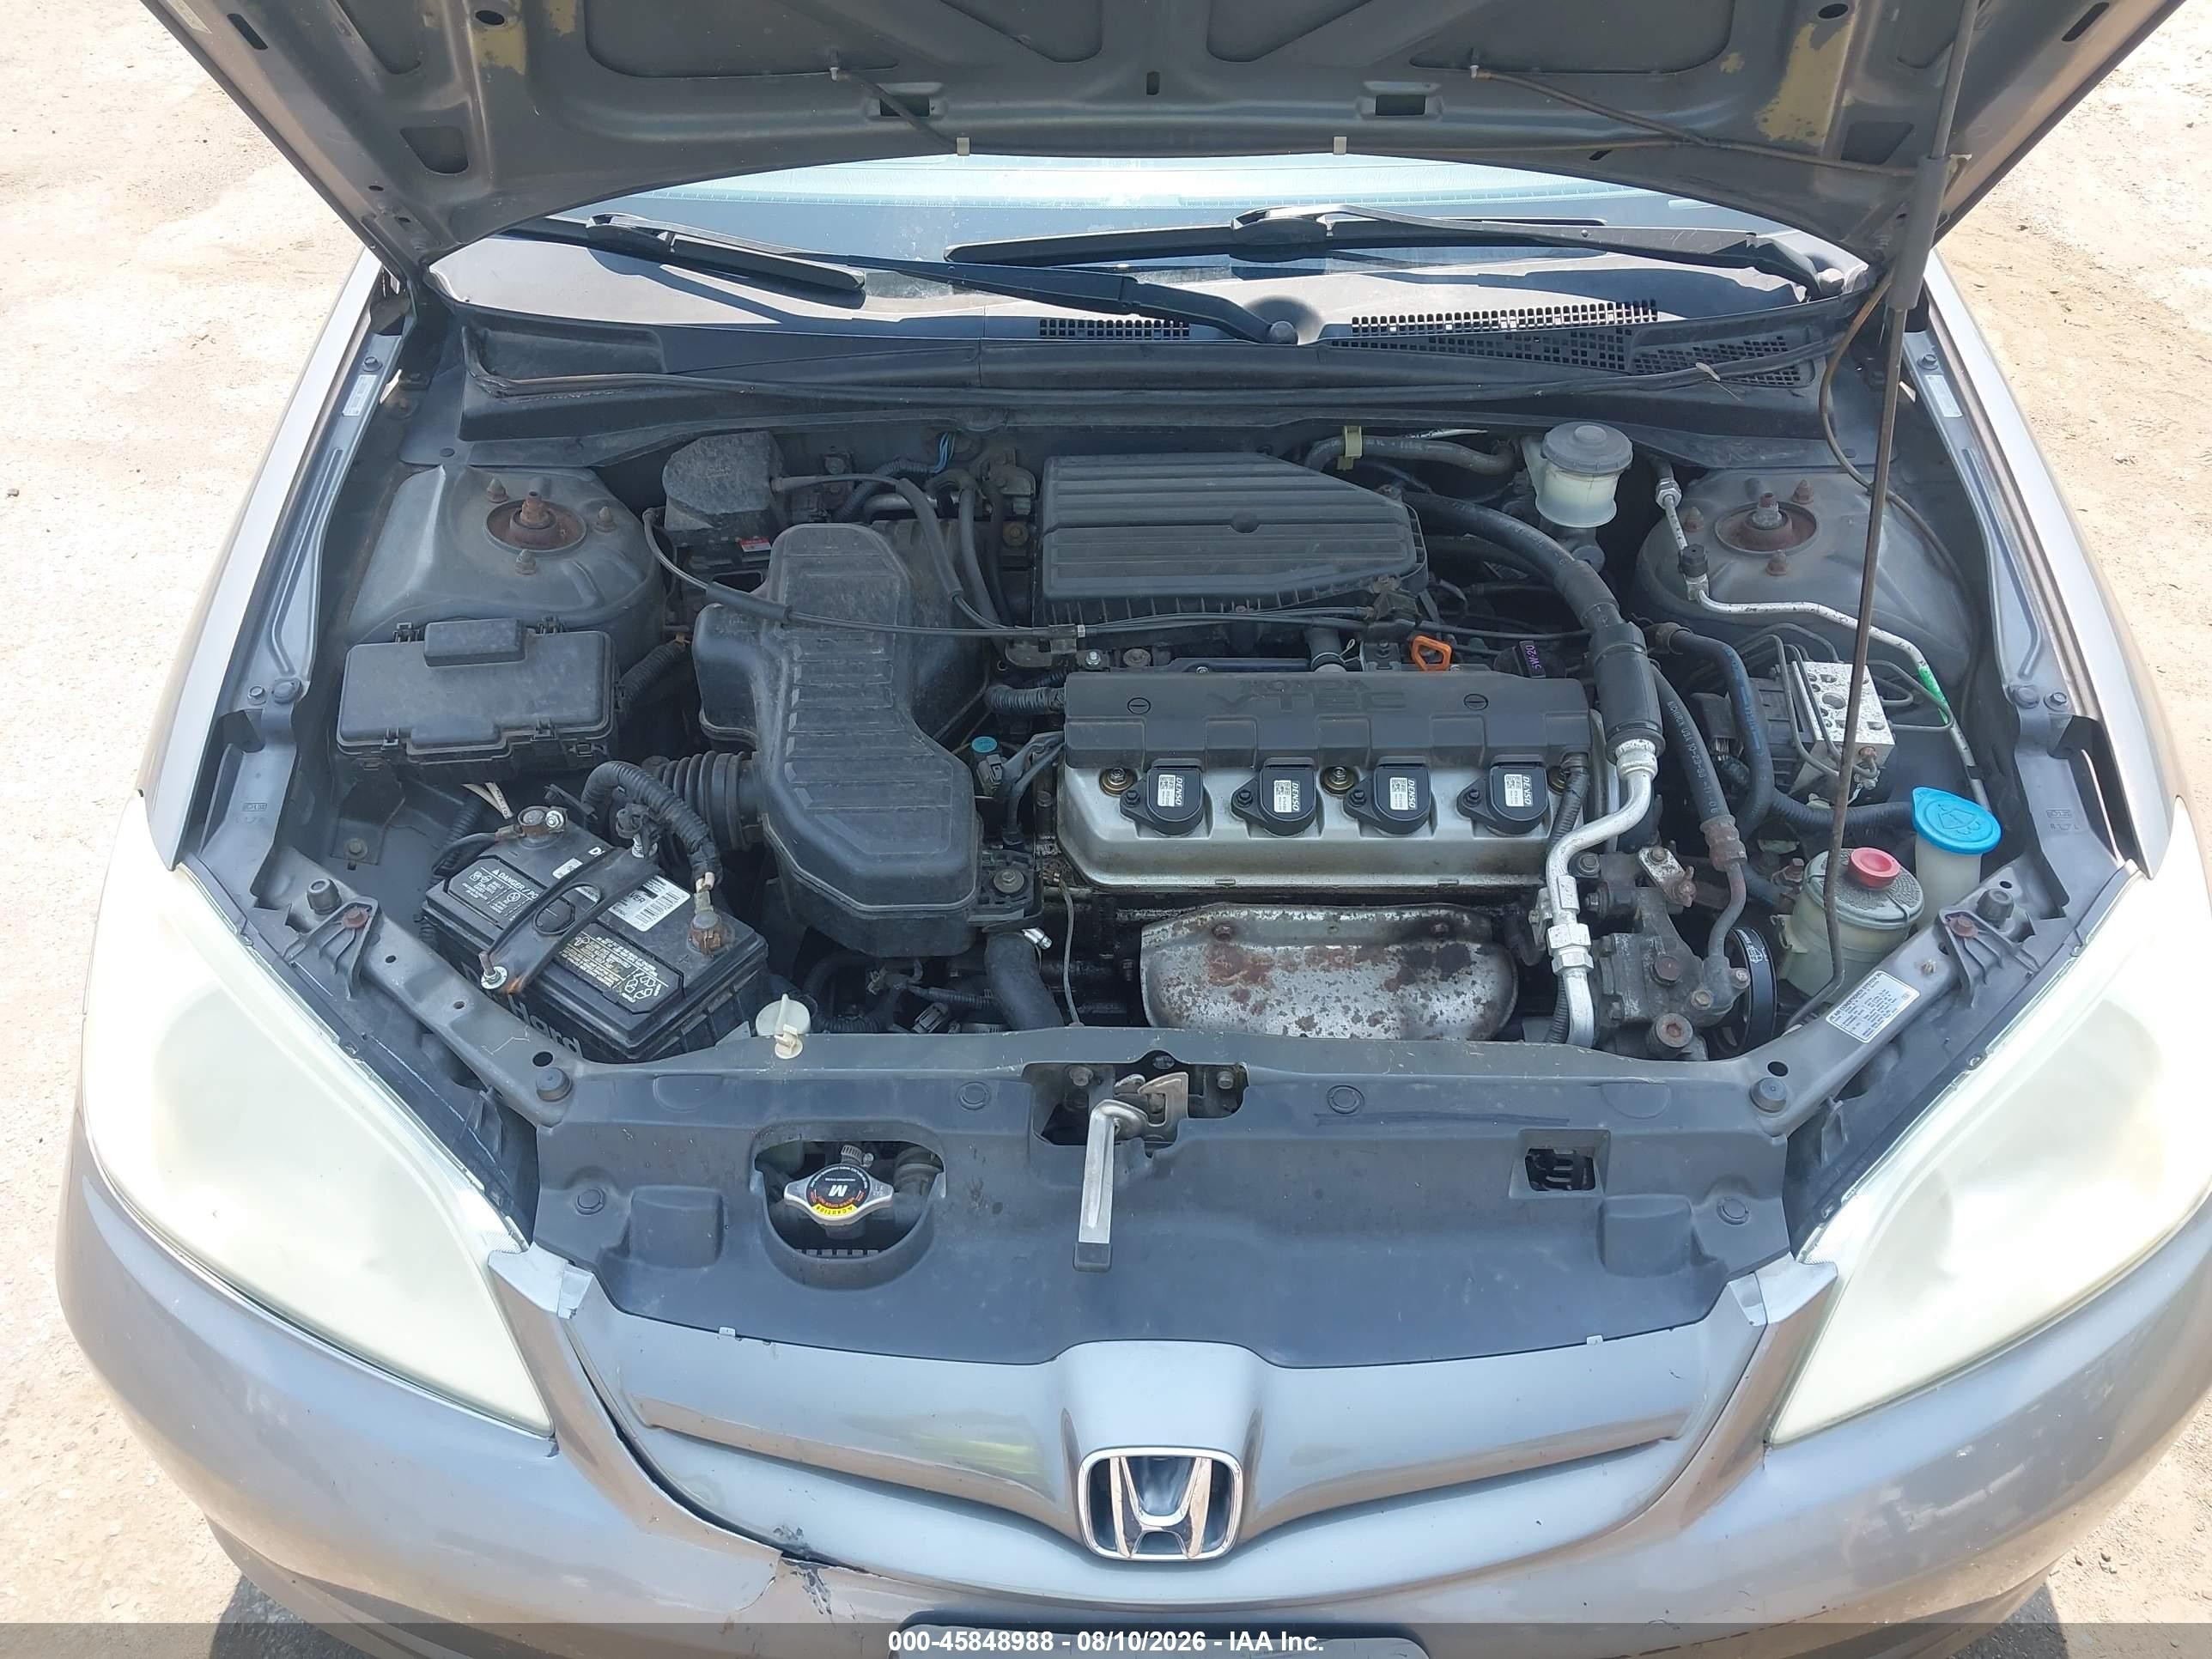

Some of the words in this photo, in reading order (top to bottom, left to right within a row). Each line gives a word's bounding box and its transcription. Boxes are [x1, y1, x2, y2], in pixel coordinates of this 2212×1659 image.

[1206, 692, 1407, 713] VTEC
[1174, 776, 1184, 805] DENSO
[1291, 781, 1300, 811] DENSO
[1407, 779, 1417, 811] DENSO
[1522, 775, 1532, 805] DENSO
[498, 872, 526, 891] DANGER
[507, 994, 584, 1058] Hard
[828, 1184, 848, 1197] M
